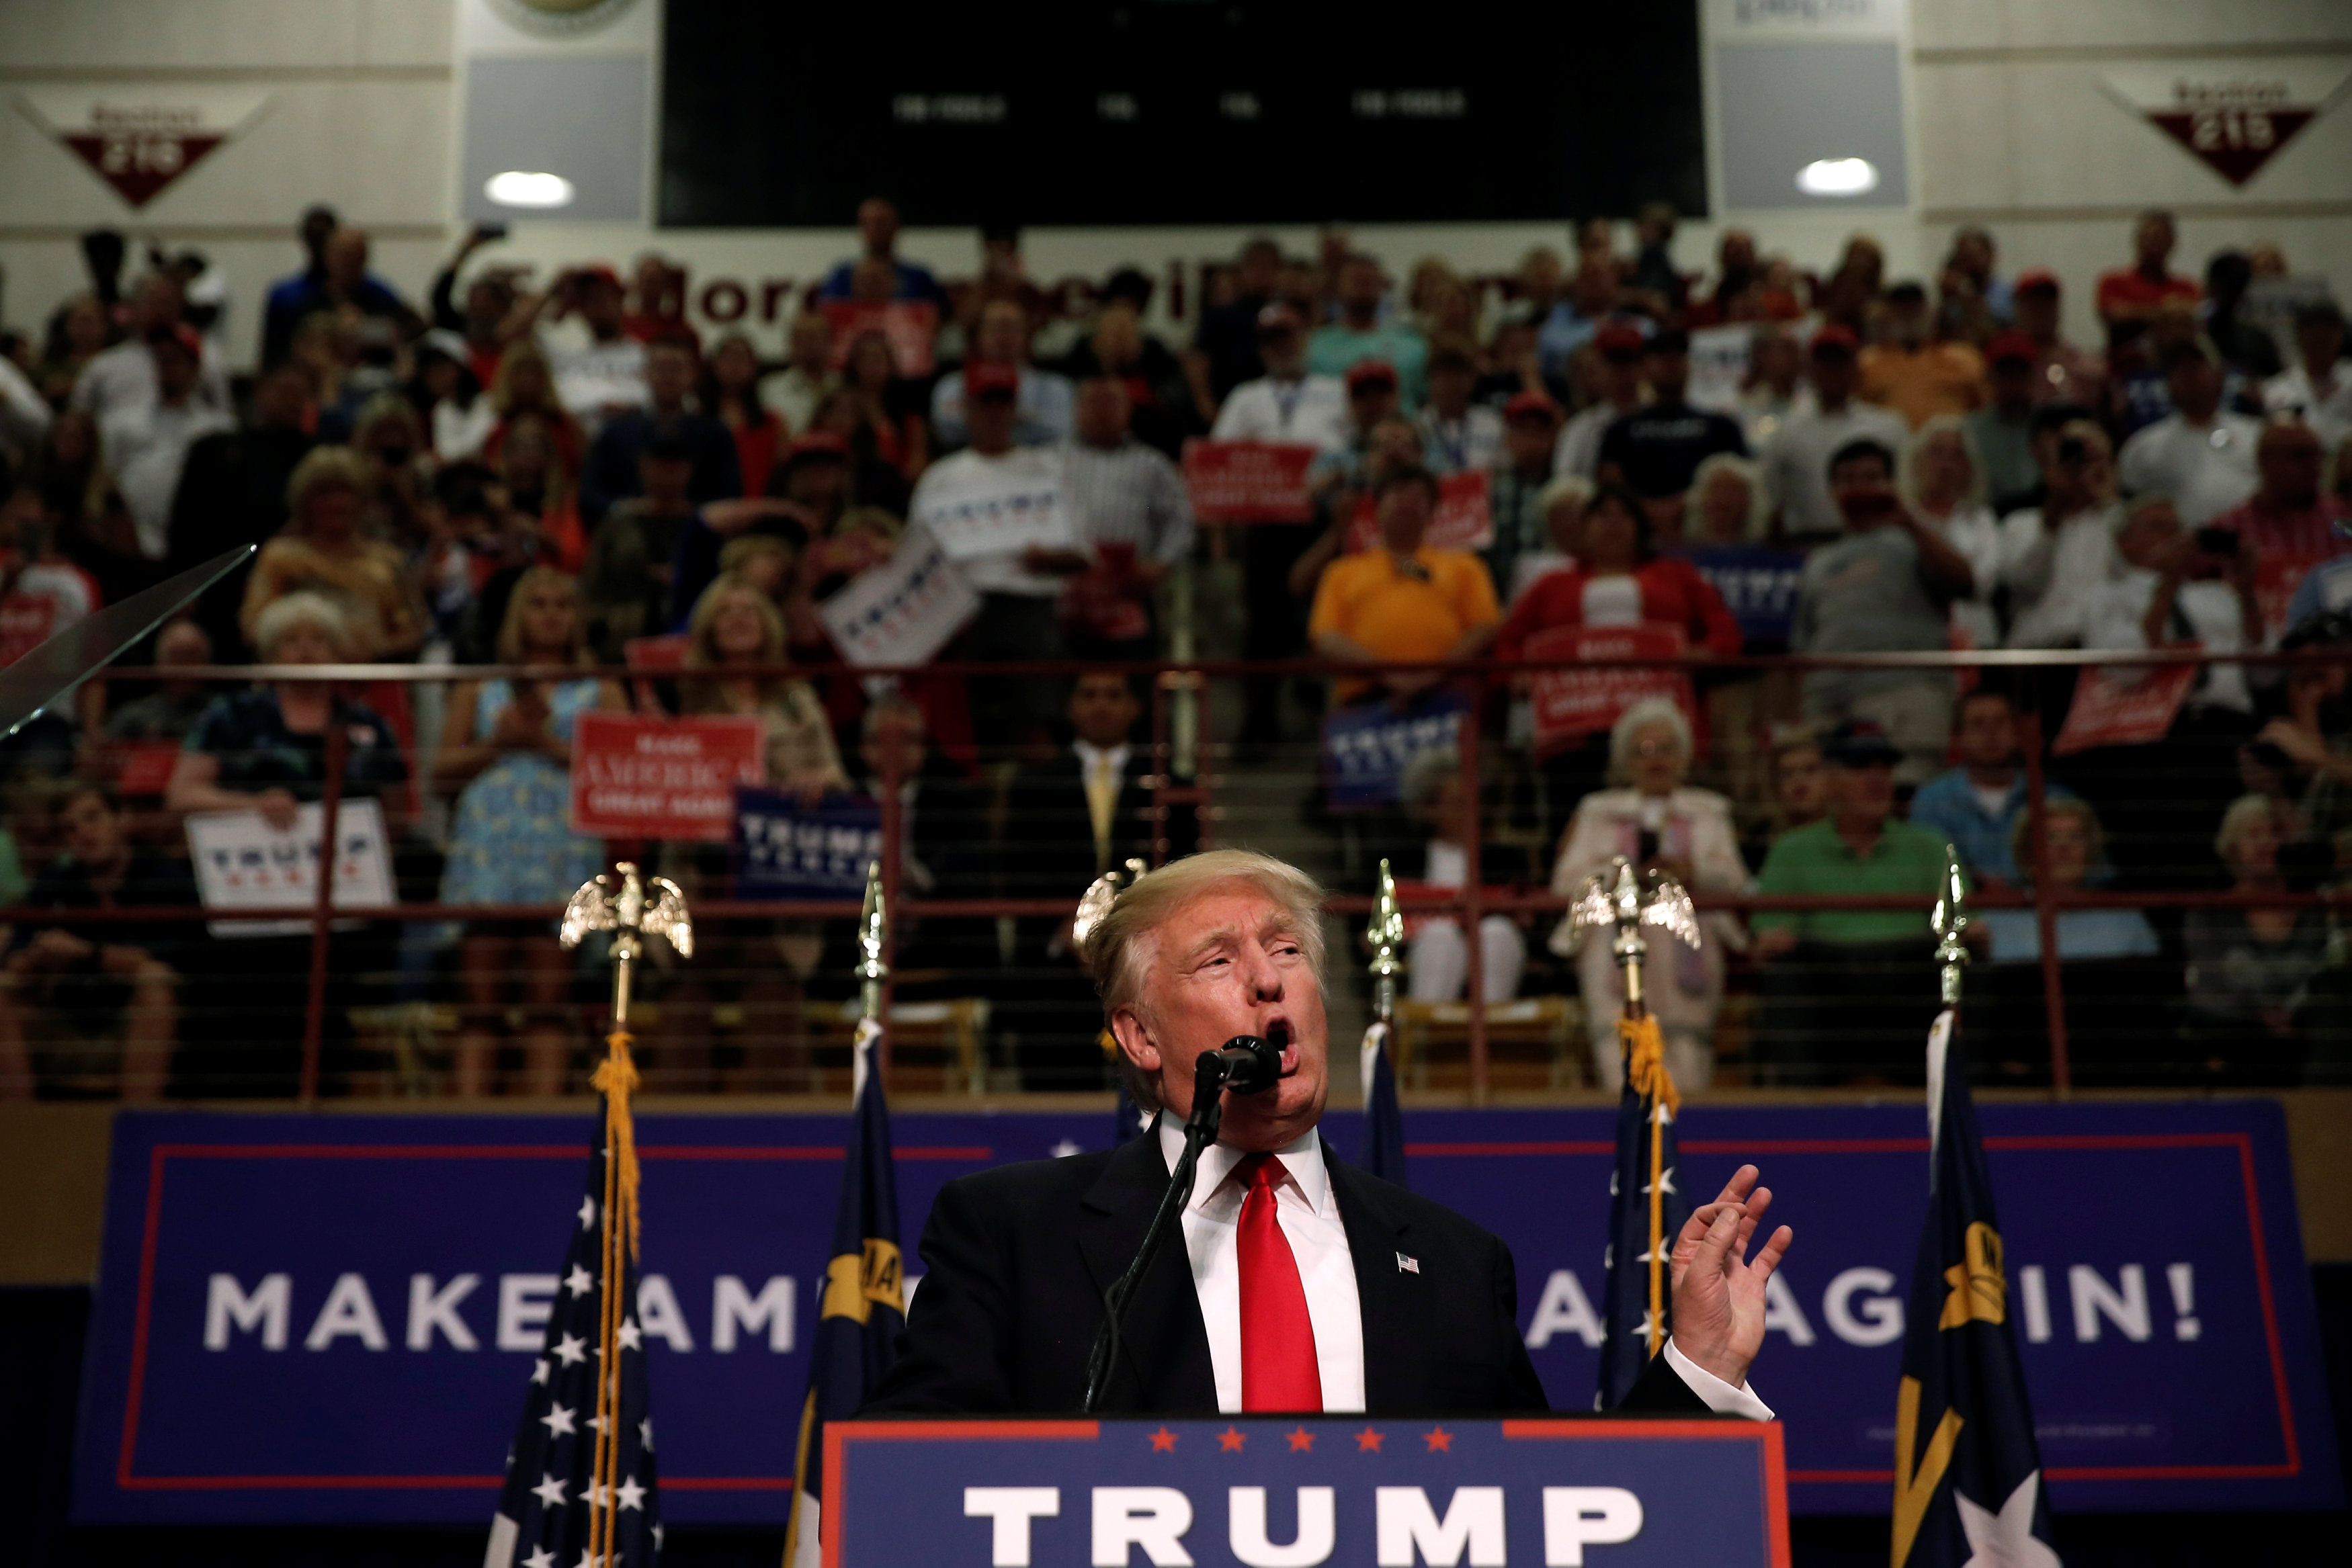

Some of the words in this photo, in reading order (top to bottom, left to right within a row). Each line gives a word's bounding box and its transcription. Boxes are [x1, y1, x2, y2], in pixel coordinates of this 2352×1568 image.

[203, 1272, 560, 1352] MAKE
[1765, 1262, 2202, 1348] AGIN!
[964, 1486, 1644, 1567] TRUMP
